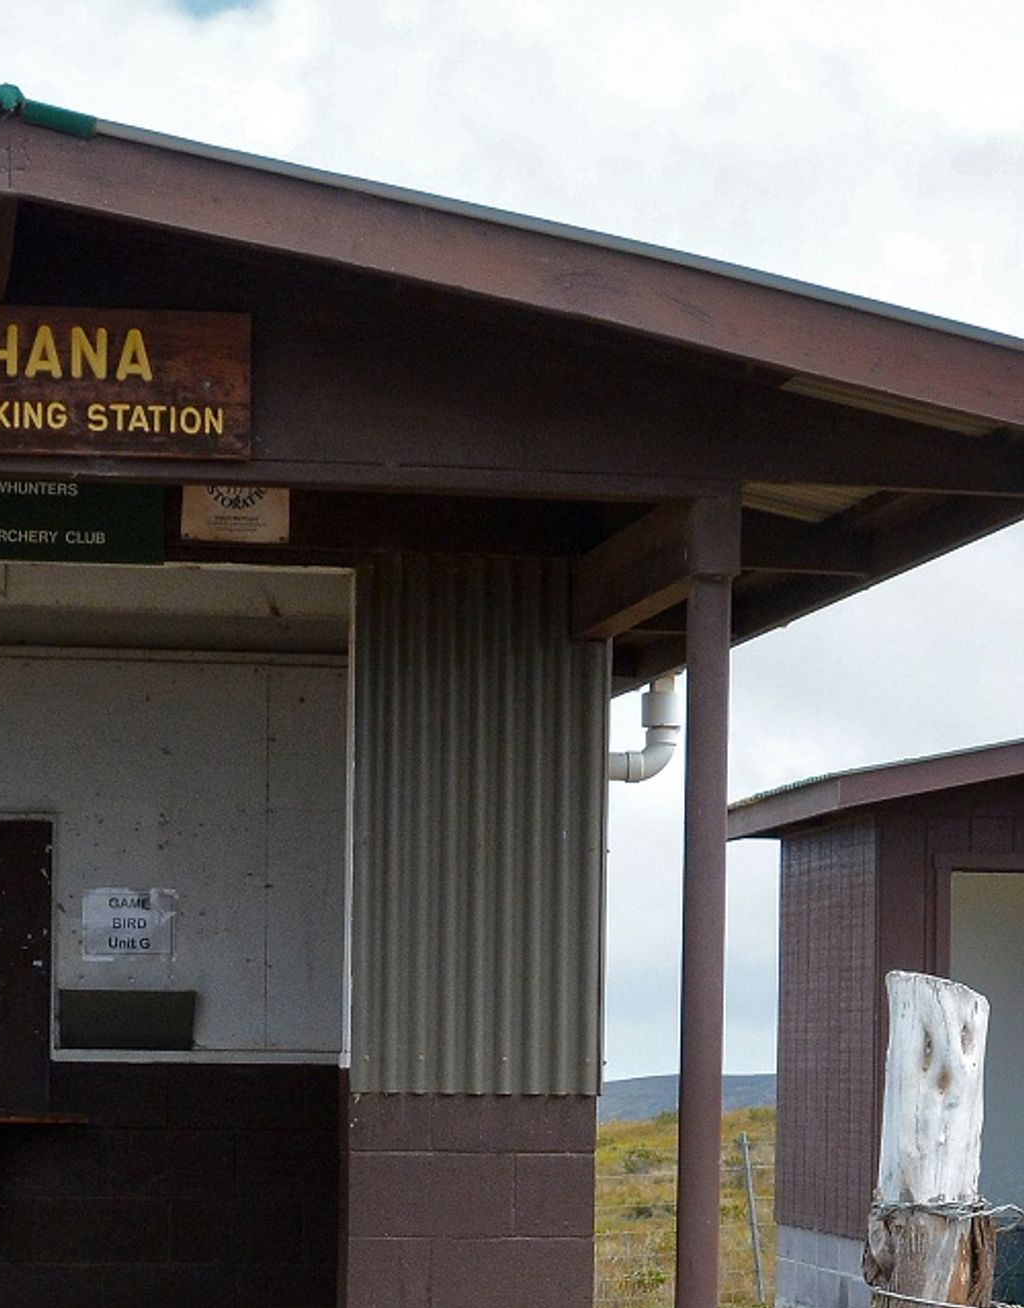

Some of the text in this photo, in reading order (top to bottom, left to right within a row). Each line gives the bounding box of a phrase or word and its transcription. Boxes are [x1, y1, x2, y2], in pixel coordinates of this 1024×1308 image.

[88, 402, 224, 435] STATION
[65, 529, 106, 545] CLUB
[108, 896, 151, 910] GAME
[112, 917, 147, 929] BIRD
[107, 936, 151, 949] Unit G
